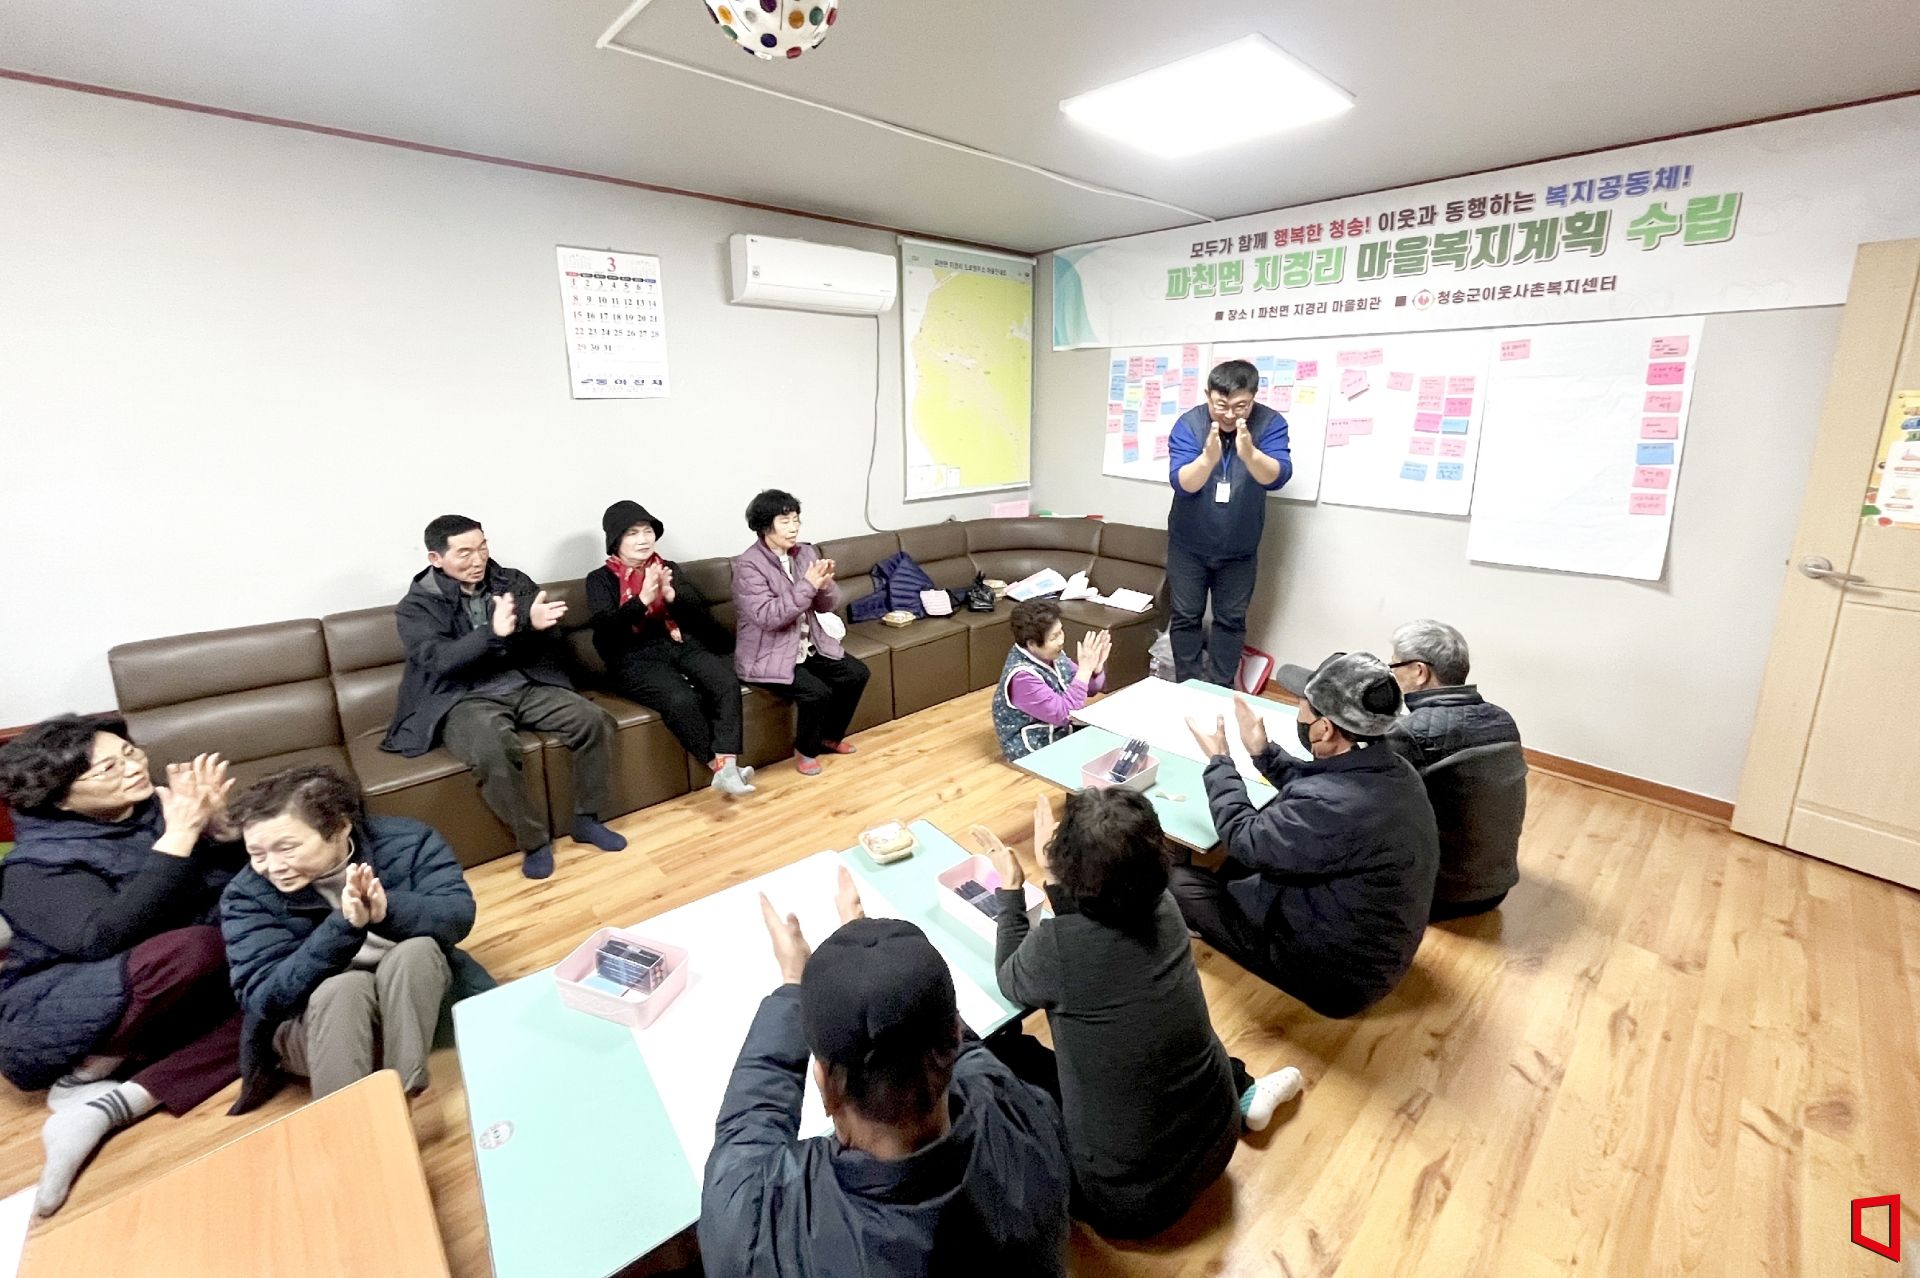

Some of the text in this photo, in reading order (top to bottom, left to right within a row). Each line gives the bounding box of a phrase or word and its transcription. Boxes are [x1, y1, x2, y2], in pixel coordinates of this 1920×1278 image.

[1190, 164, 1694, 258] 모두가 함께 행복한 청송! 이웃과 동행하는 복지공동체!
[1164, 191, 1743, 300] 파천면 지경리 마을복지계획 수립
[607, 257, 617, 272] 3
[1437, 275, 1618, 305] 청송군이웃사촌복지센터
[1227, 304, 1248, 321] 장소
[1257, 304, 1290, 319] 파천면
[1293, 300, 1328, 316] 지경리
[1332, 296, 1383, 313] 마을회관
